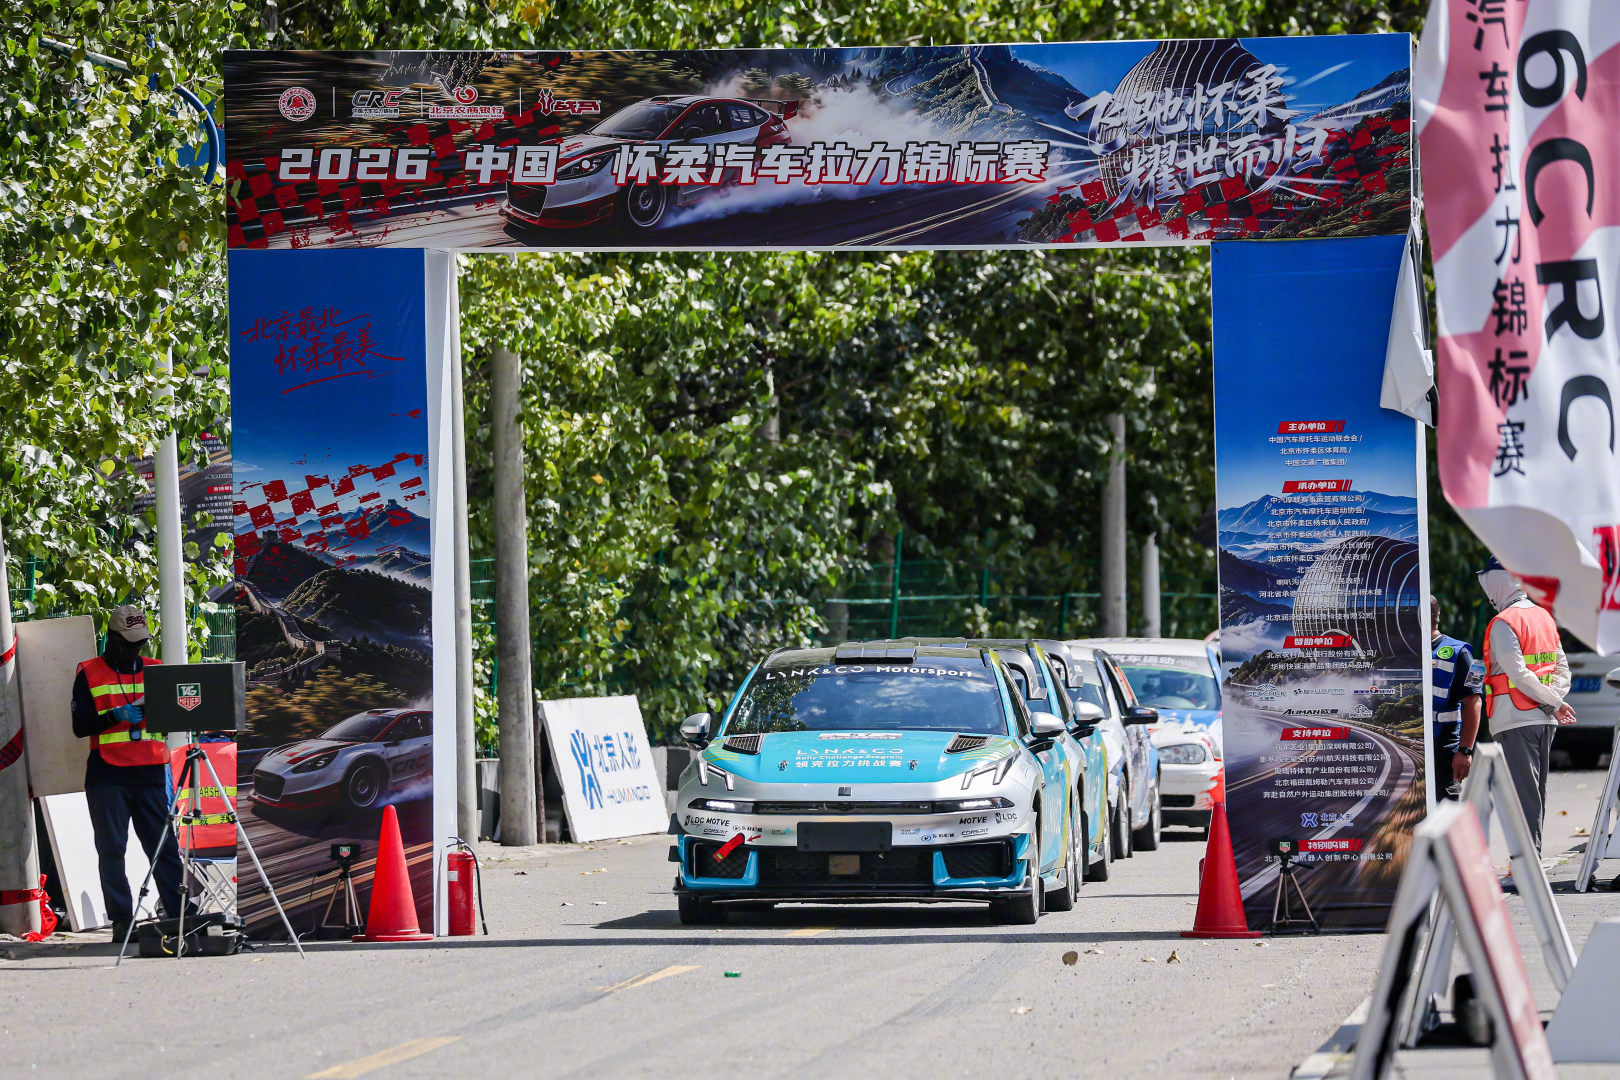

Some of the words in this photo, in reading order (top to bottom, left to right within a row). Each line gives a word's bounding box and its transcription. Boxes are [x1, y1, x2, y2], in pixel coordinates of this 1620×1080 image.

[352, 90, 402, 107] CRC
[429, 106, 504, 115] 北京农商银行
[1064, 63, 1302, 157] 飞驰怀柔
[278, 147, 430, 181] 2026
[464, 143, 560, 185] 中国
[612, 139, 1049, 186] 怀柔汽车拉力锦标赛
[239, 305, 371, 343] 北京最北
[273, 322, 405, 376] 怀柔最美
[1288, 421, 1327, 431] 主办单位
[1297, 481, 1337, 490] 承办单位
[1294, 637, 1333, 646] 赞助单位
[876, 665, 973, 678] Motorsport
[180, 685, 197, 696] TAG
[179, 697, 200, 708] HEUER
[1292, 729, 1332, 738] 支持单位
[795, 760, 903, 768] 领克拉力挑战赛
[705, 818, 731, 827] MOTVE
[959, 816, 988, 825] MOTVE
